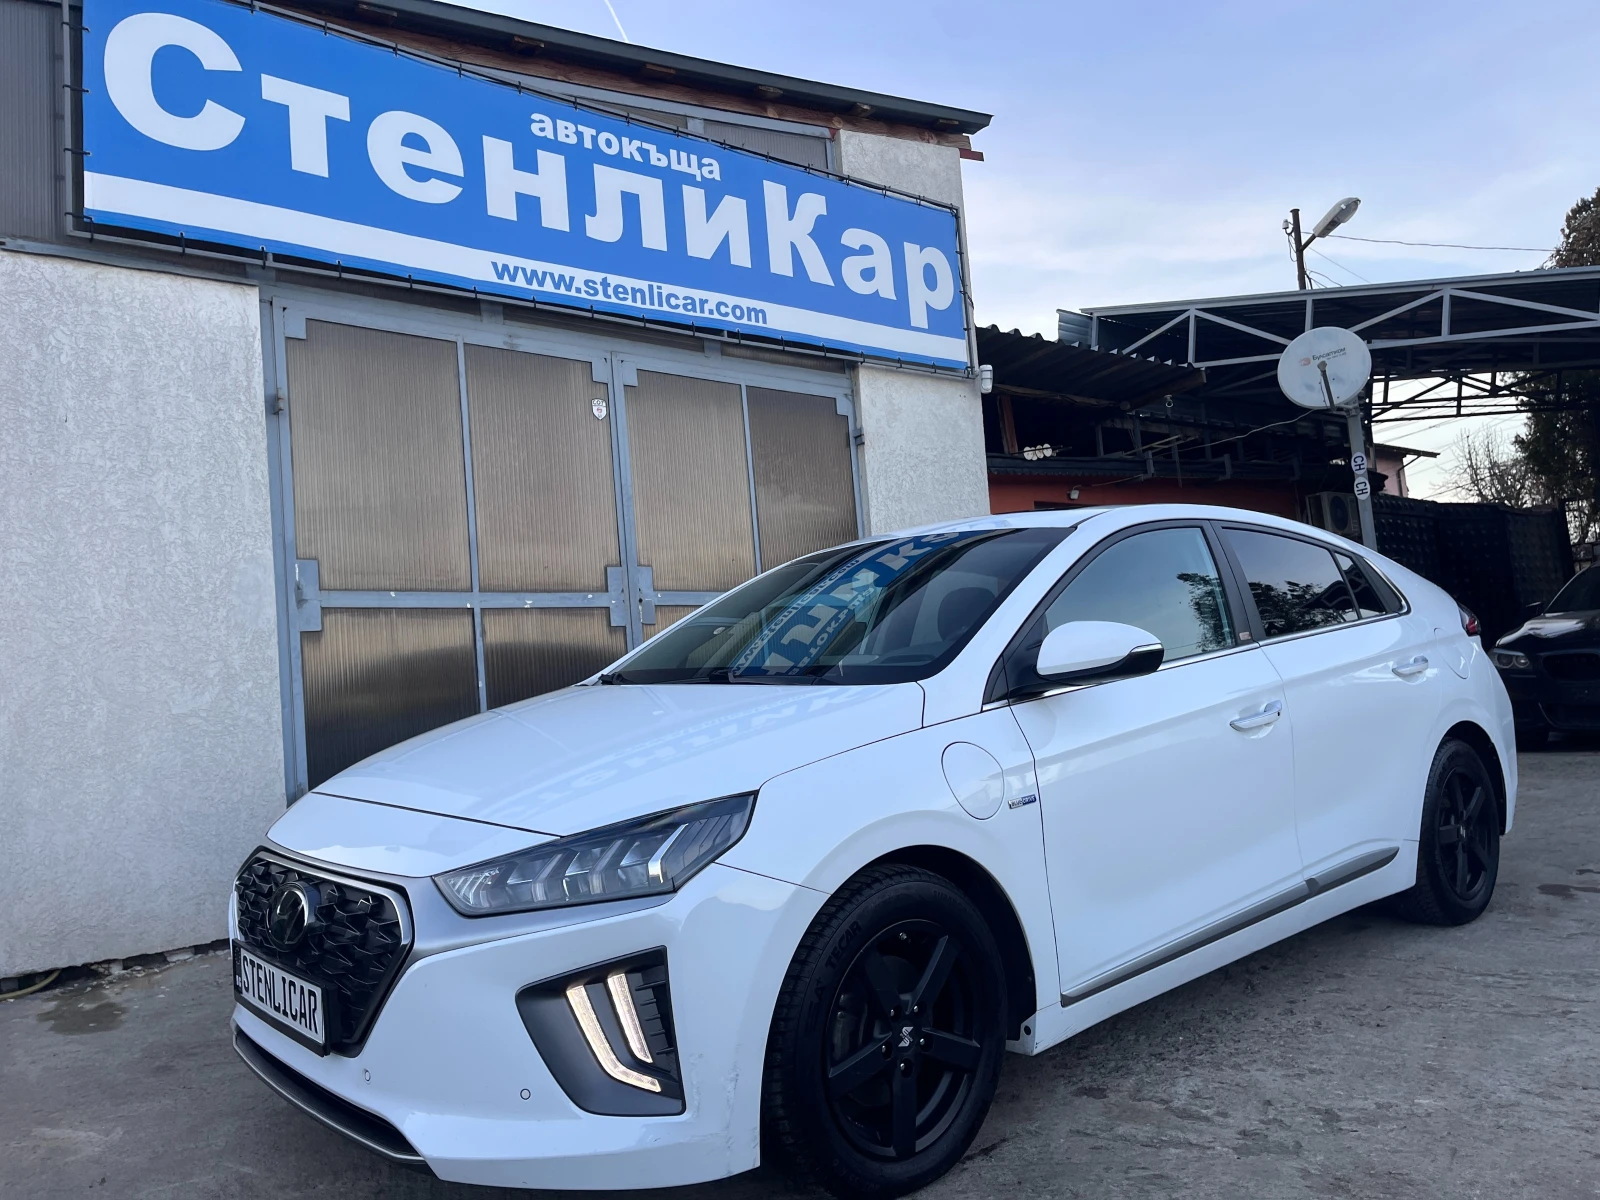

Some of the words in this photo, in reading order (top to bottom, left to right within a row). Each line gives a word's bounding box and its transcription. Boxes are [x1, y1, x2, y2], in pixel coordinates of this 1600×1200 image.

[103, 12, 955, 330] СтенлиКар
[530, 113, 721, 182] автокъща
[491, 262, 768, 325] www.stenlicar.com
[1353, 455, 1365, 471] CH
[1355, 481, 1368, 496] CH
[825, 920, 862, 969] TECAR
[242, 955, 319, 1035] STENLICAR
